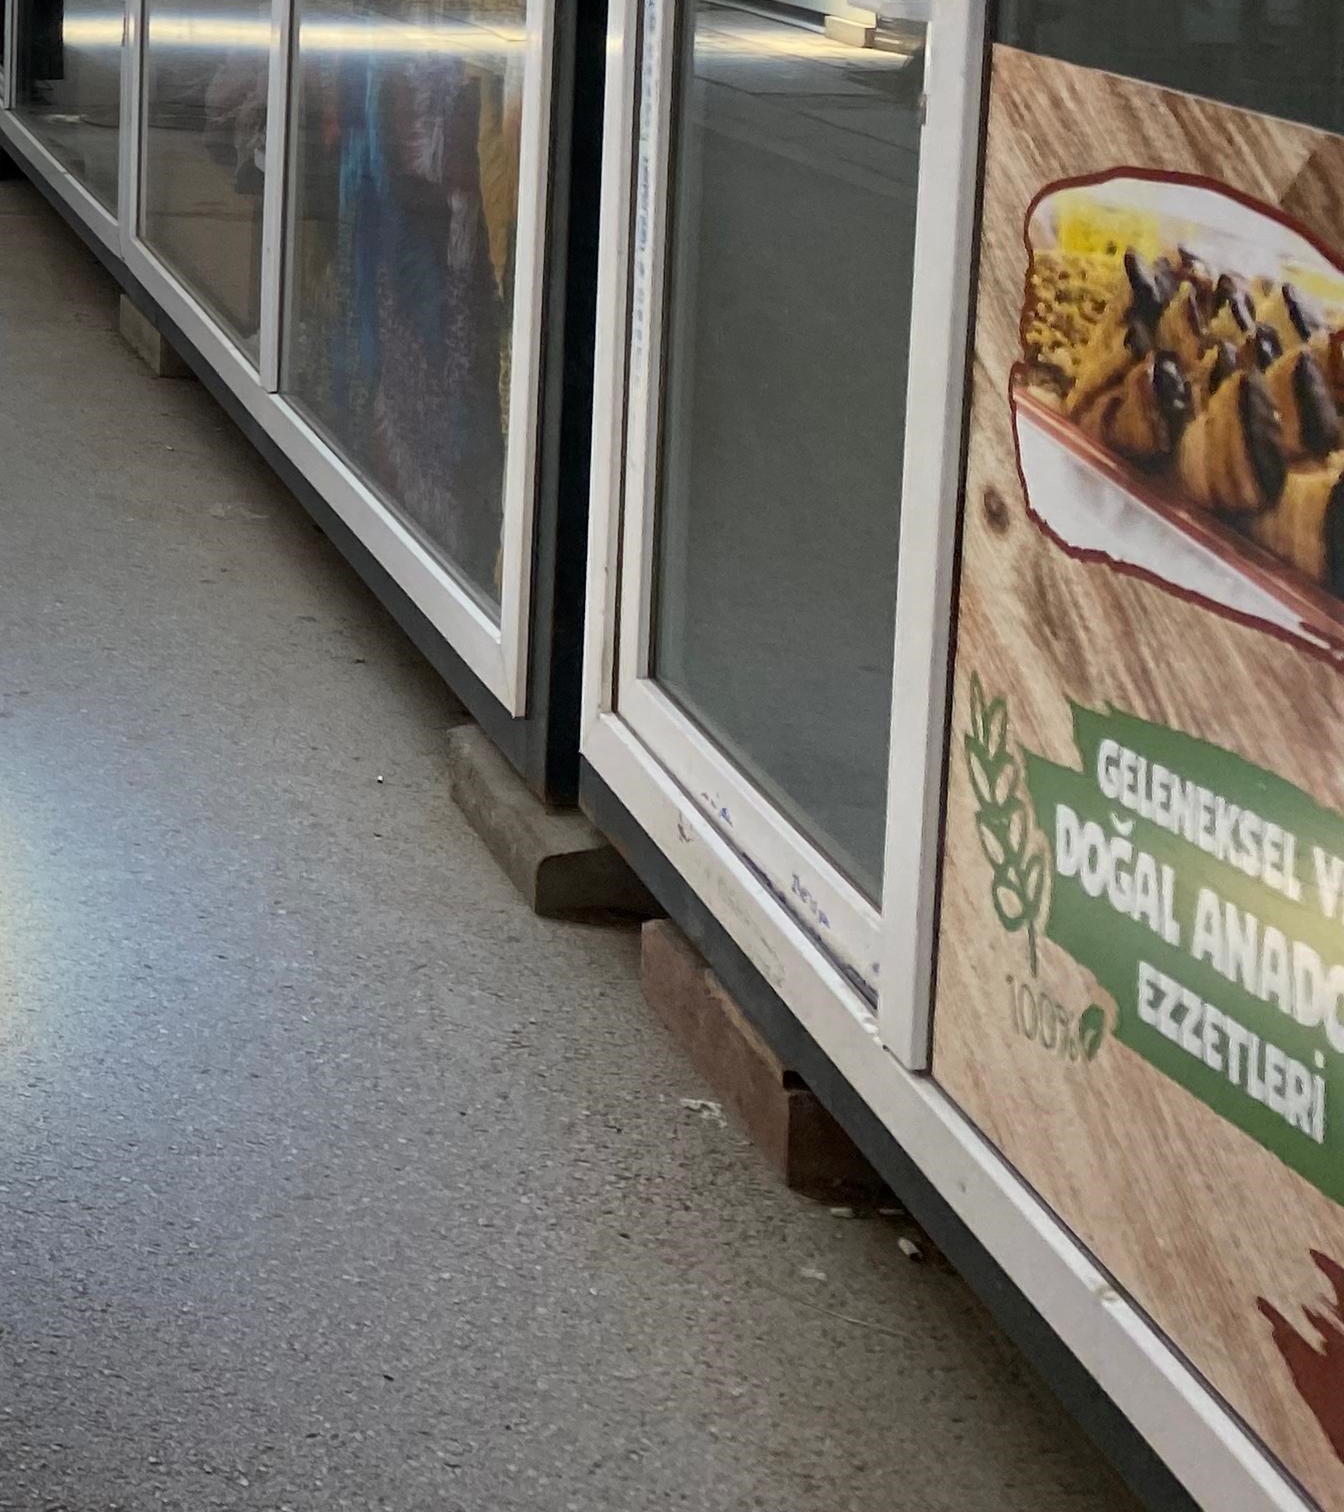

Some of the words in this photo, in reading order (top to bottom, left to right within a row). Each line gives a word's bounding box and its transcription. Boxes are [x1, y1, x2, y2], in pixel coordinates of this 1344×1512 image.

[1056, 803, 1181, 947] DOĞAL
[1097, 738, 1302, 903] GELENEKSEL
[1311, 845, 1344, 919] V
[1138, 960, 1327, 1144] EZZETLERİ
